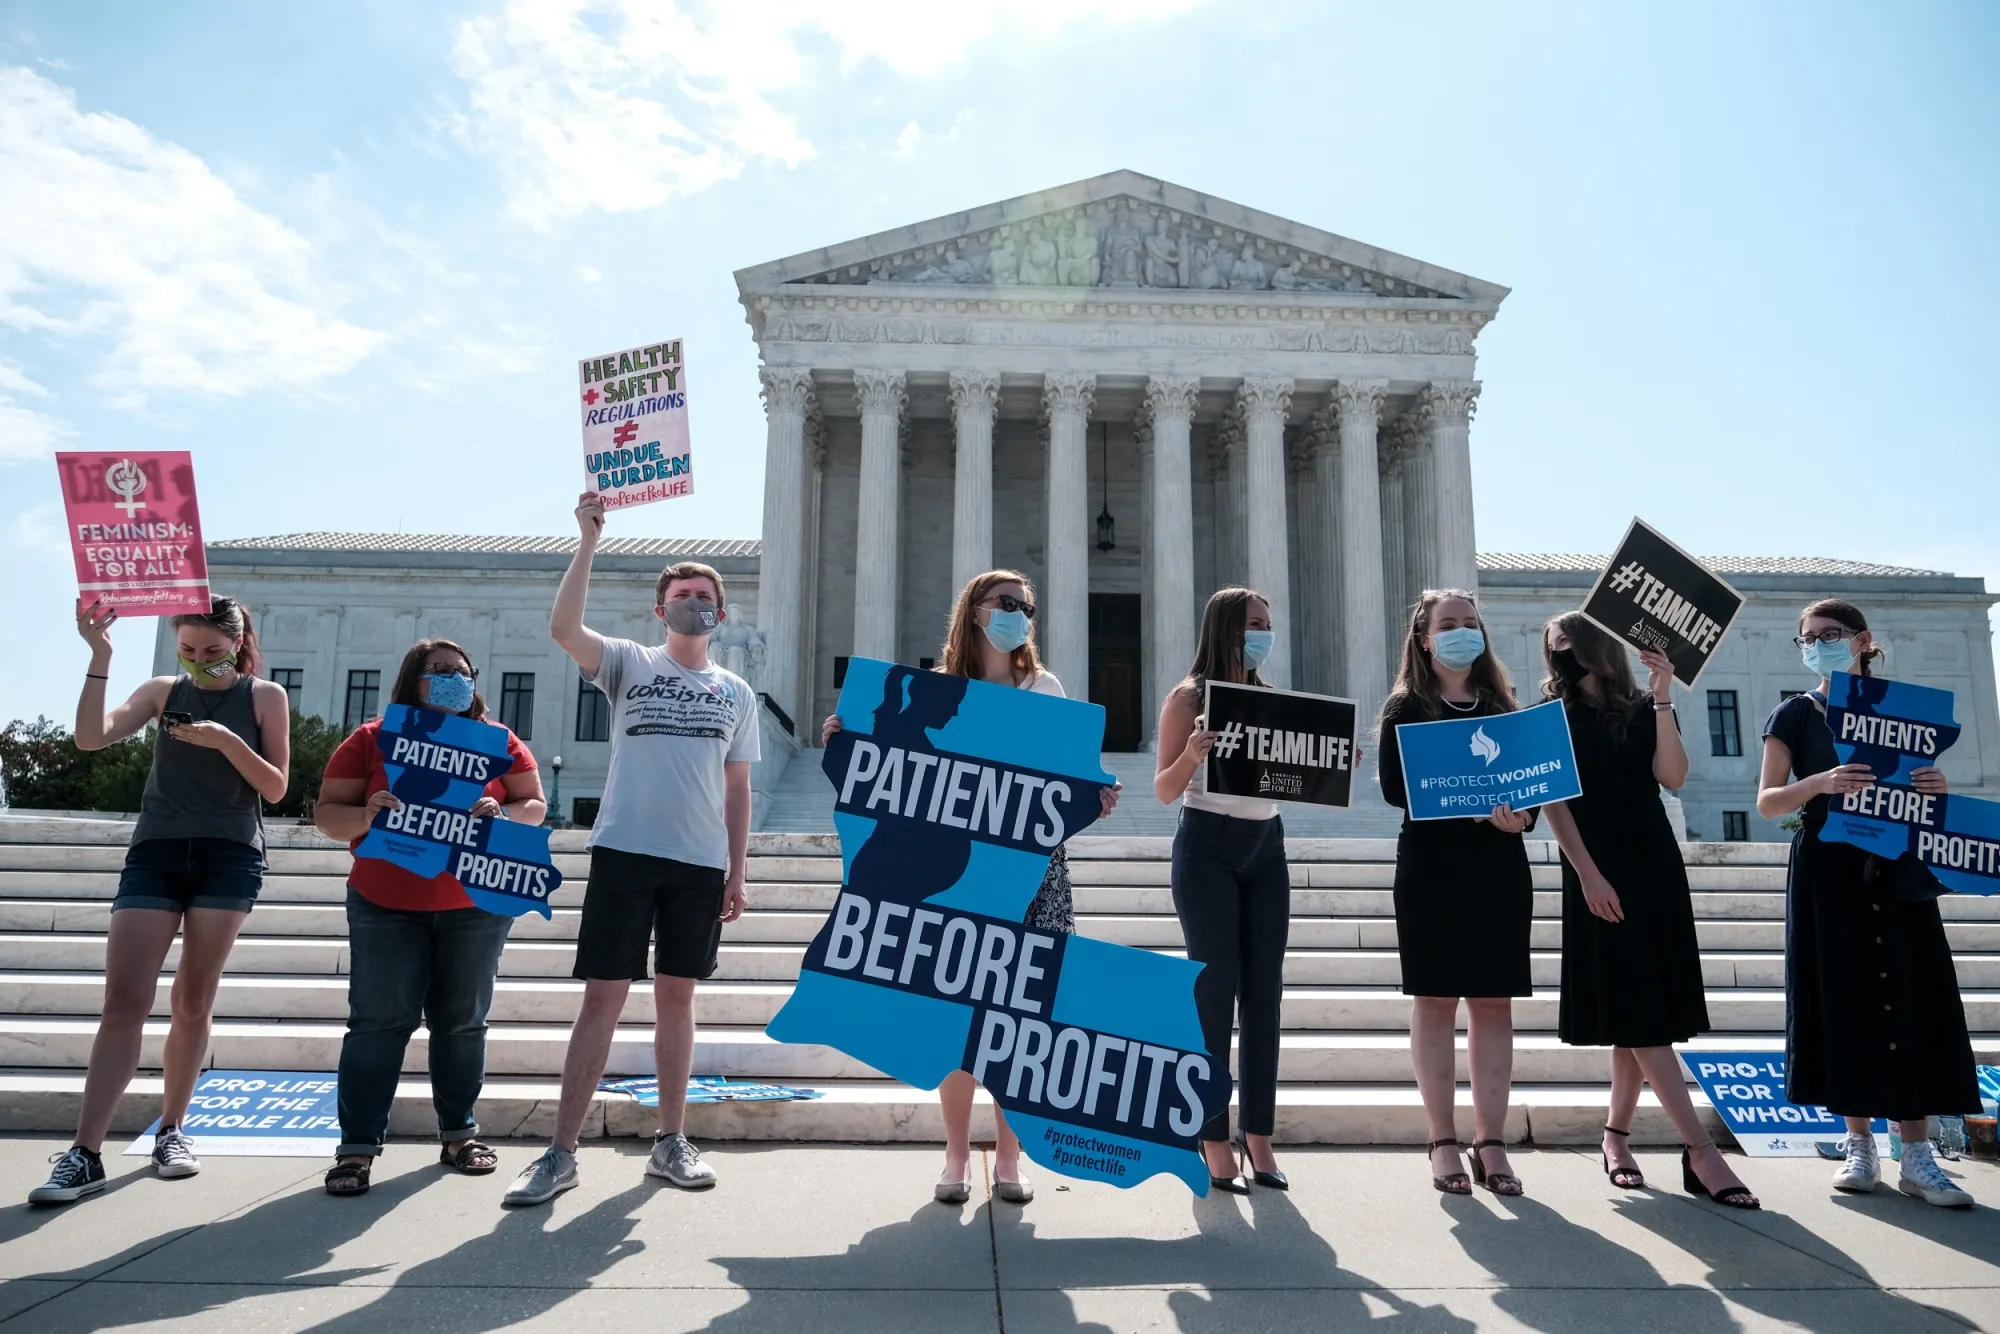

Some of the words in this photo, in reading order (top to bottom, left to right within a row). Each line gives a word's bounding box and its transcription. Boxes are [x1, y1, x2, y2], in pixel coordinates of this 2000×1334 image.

[583, 341, 680, 384] HEALTH
[603, 367, 681, 404] SAFETY
[586, 441, 664, 474] UNDUE
[598, 453, 690, 492] BURDEN
[77, 522, 195, 541] FEMINISM:
[85, 545, 189, 563] EQUALITY
[95, 562, 137, 577] FOR
[1609, 560, 1722, 655] #TEAMLIFE
[1637, 634, 1650, 646] FOR
[1641, 627, 1668, 649] UNITED
[650, 673, 683, 687] BE
[1214, 721, 1350, 771] #TEAMLIFE
[1841, 712, 1938, 755] PATIENTS
[391, 737, 490, 781] PATIENTS
[1420, 759, 1562, 789] #PROTECTWOMEN
[840, 739, 1072, 848] PATIENTS
[1271, 777, 1303, 788] UNITED
[1271, 785, 1285, 793] FOR
[1286, 786, 1302, 795] LIFE
[1440, 782, 1549, 808] #PROTECTLIFE
[1843, 783, 1937, 826] BEFORE
[386, 801, 483, 847] BEFORE
[1917, 830, 2000, 874] PROFIT
[455, 852, 549, 898] PROFITS
[823, 892, 1055, 1014] BEFORE
[197, 1078, 338, 1094] PRO-LIFE
[973, 1009, 1211, 1138] PROFITS
[1698, 1062, 1785, 1079] PRO-L
[189, 1096, 250, 1110] FOR
[255, 1097, 321, 1111] THE
[1712, 1084, 1774, 1100] FOR
[1726, 1106, 1836, 1124] WHOLE
[1044, 1126, 1142, 1162] #protectwomen
[1052, 1147, 1126, 1177] #protectlife
